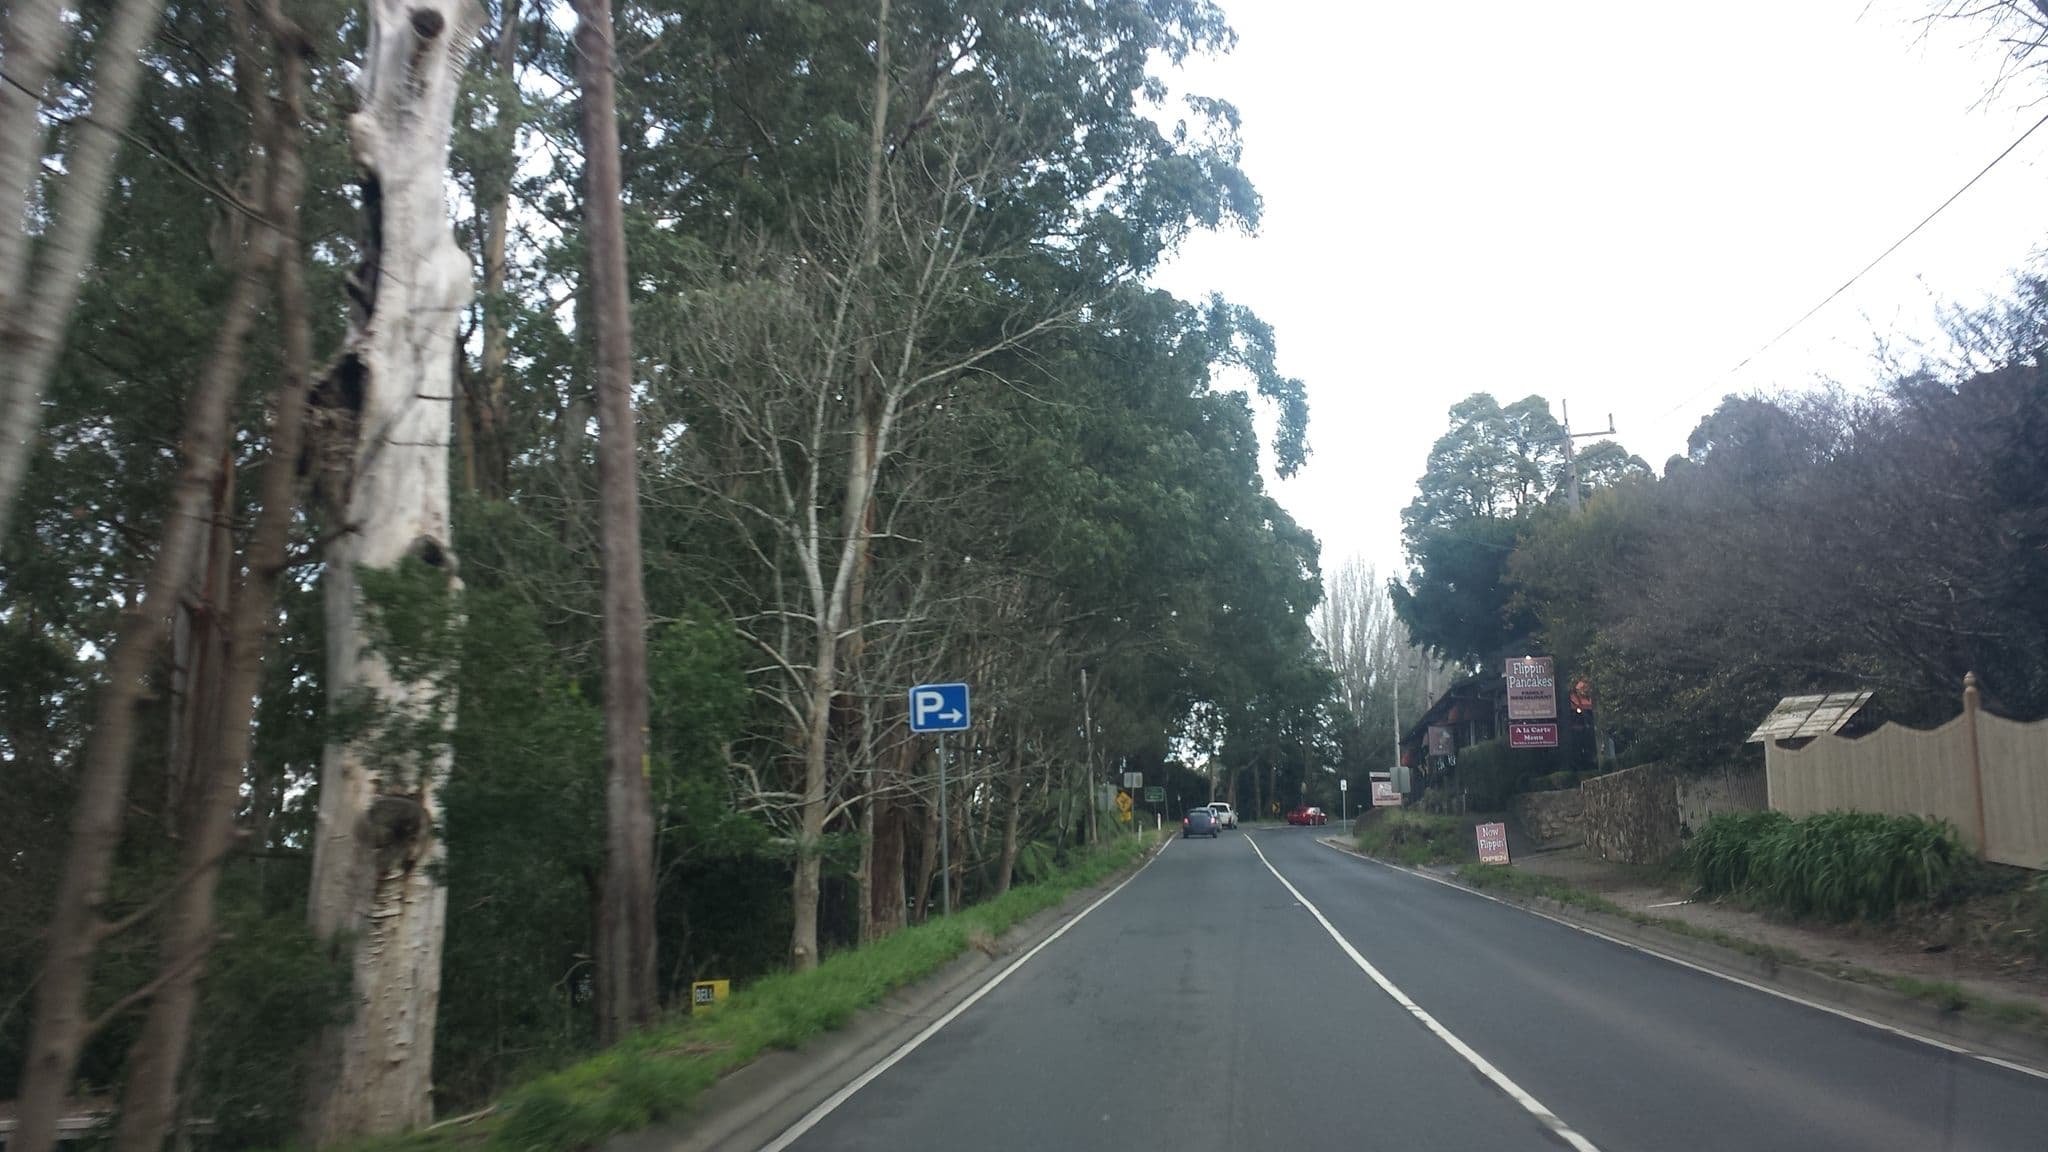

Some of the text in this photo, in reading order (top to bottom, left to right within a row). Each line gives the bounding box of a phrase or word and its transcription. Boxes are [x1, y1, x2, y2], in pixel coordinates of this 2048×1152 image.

[1513, 662, 1547, 678] Flippin'
[1509, 675, 1553, 688] Pancakes
[916, 691, 945, 726] P
[1482, 826, 1499, 837] Now
[1481, 855, 1507, 863] OPEN
